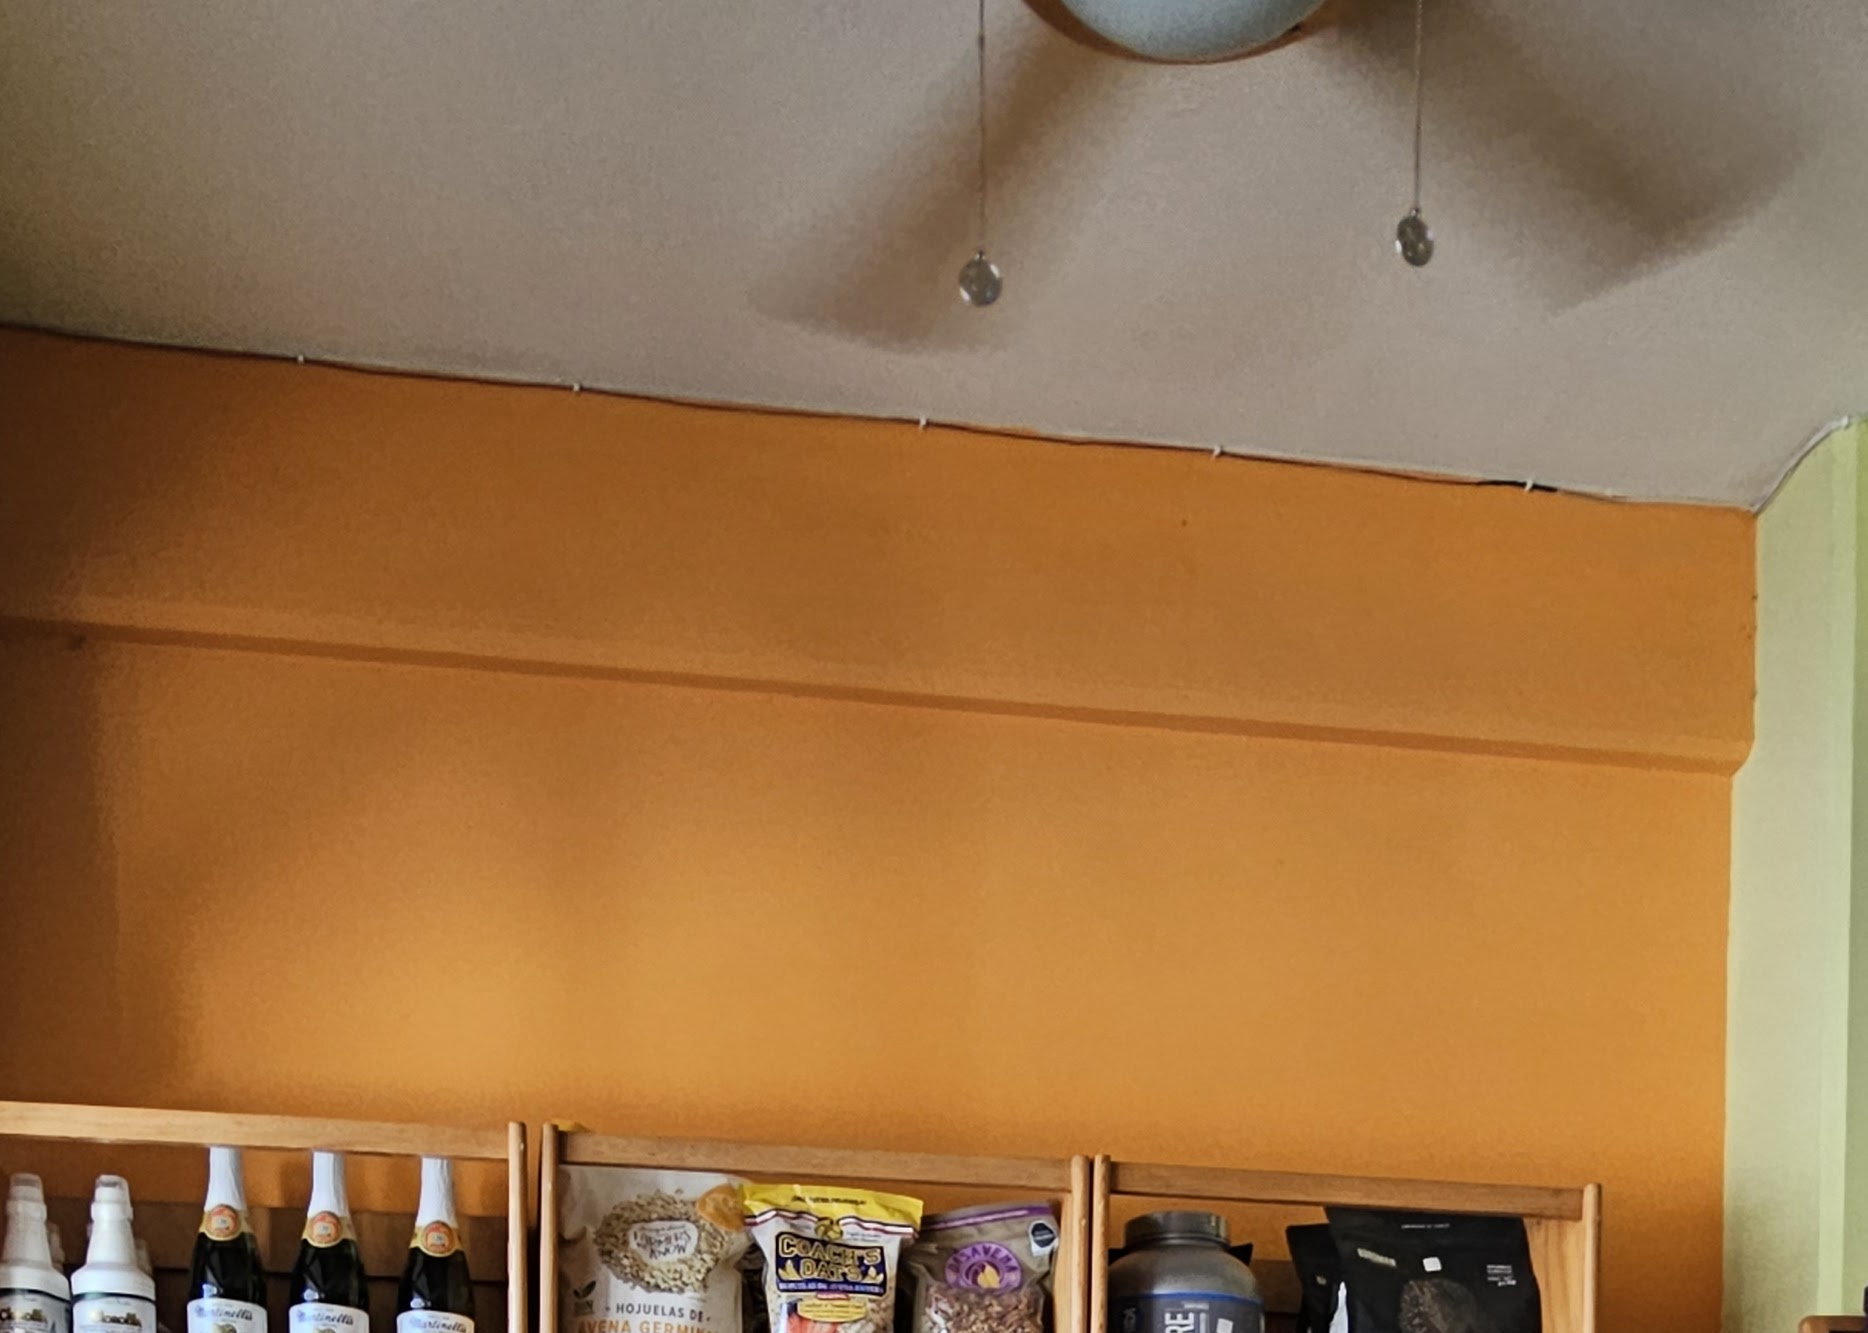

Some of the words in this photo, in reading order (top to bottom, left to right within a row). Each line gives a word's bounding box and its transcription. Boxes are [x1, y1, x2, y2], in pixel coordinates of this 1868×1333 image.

[779, 1235, 881, 1267] COACH'S
[802, 1259, 863, 1282] OATS
[616, 1303, 685, 1318] HOJUELAS
[690, 1309, 704, 1322] DE
